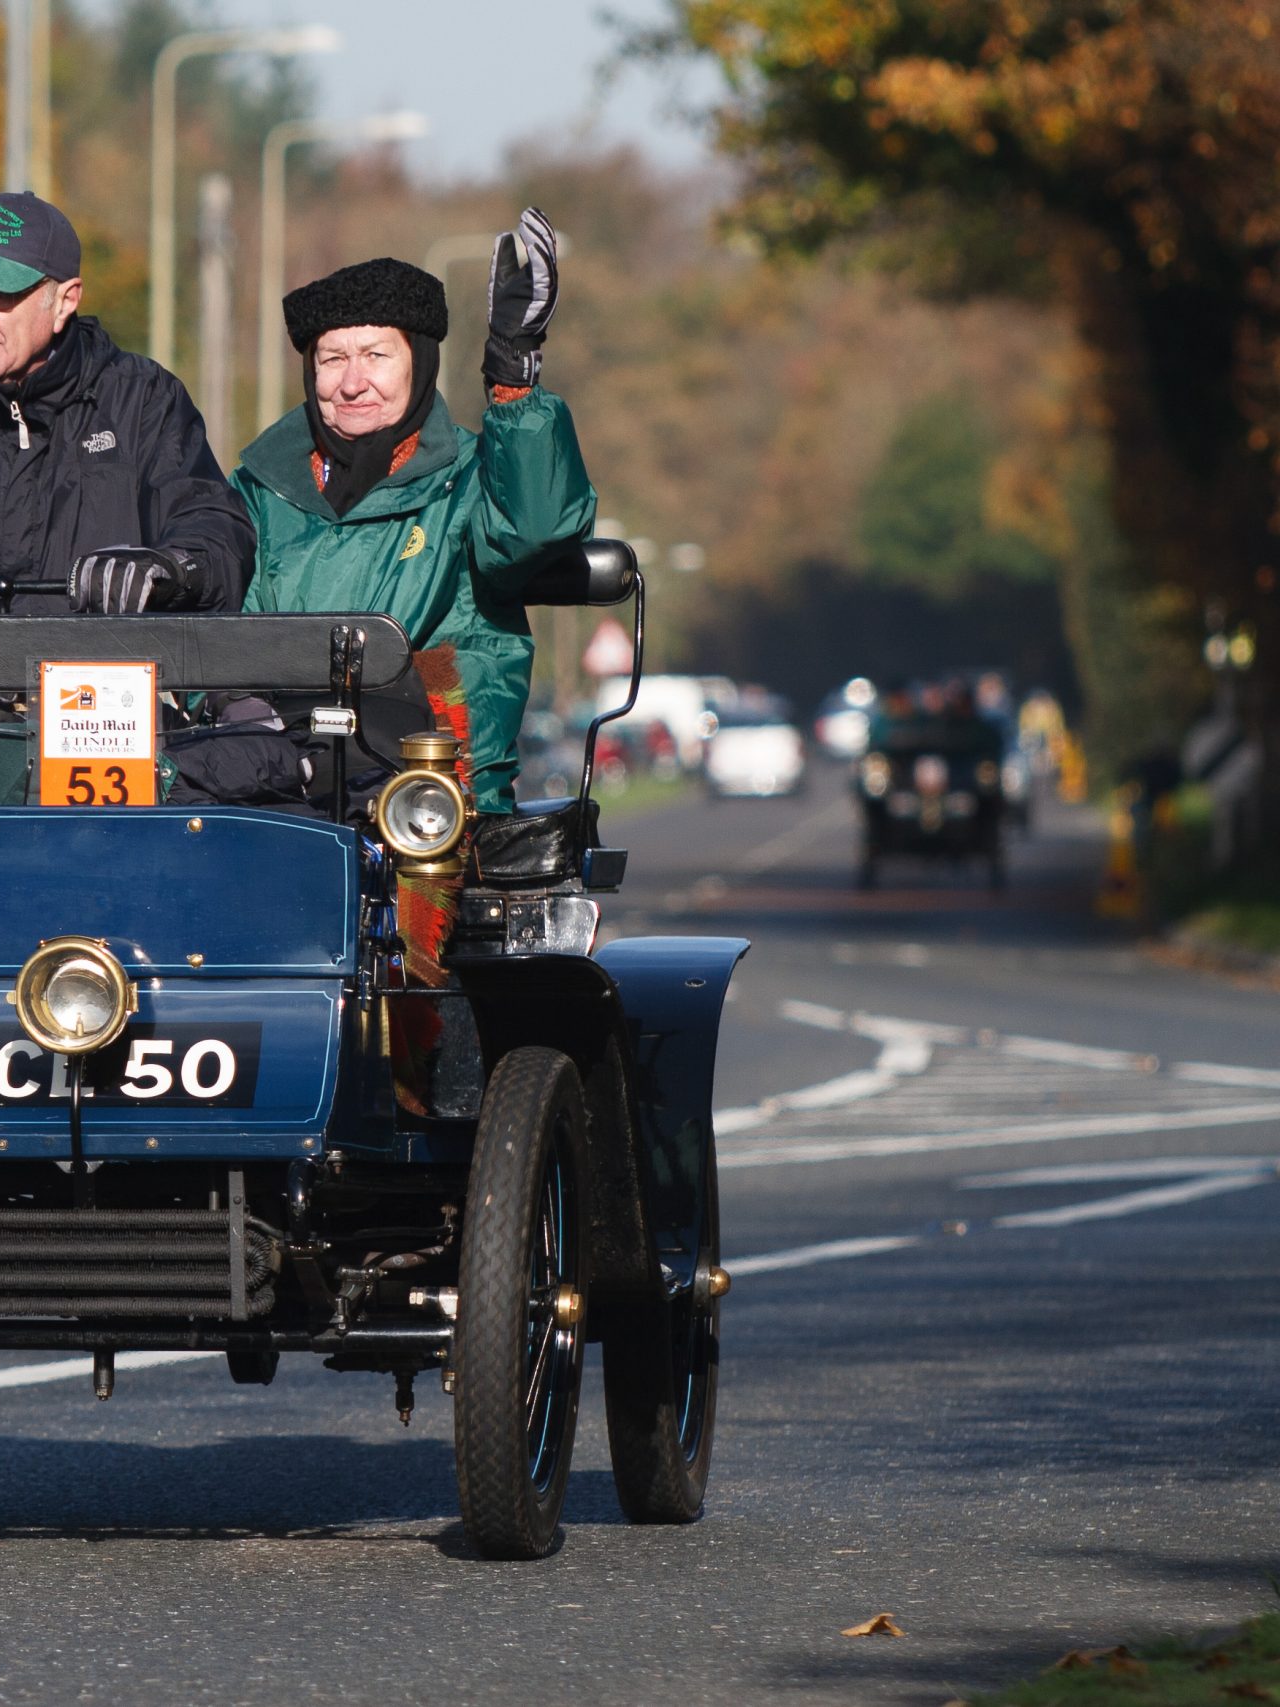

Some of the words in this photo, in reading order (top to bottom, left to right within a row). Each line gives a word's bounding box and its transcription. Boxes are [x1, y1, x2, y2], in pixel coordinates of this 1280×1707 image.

[61, 719, 99, 734] Daily
[103, 719, 136, 730] Mail
[72, 737, 135, 746] TINDLE
[66, 766, 129, 806] 53
[120, 1039, 237, 1098] 50
